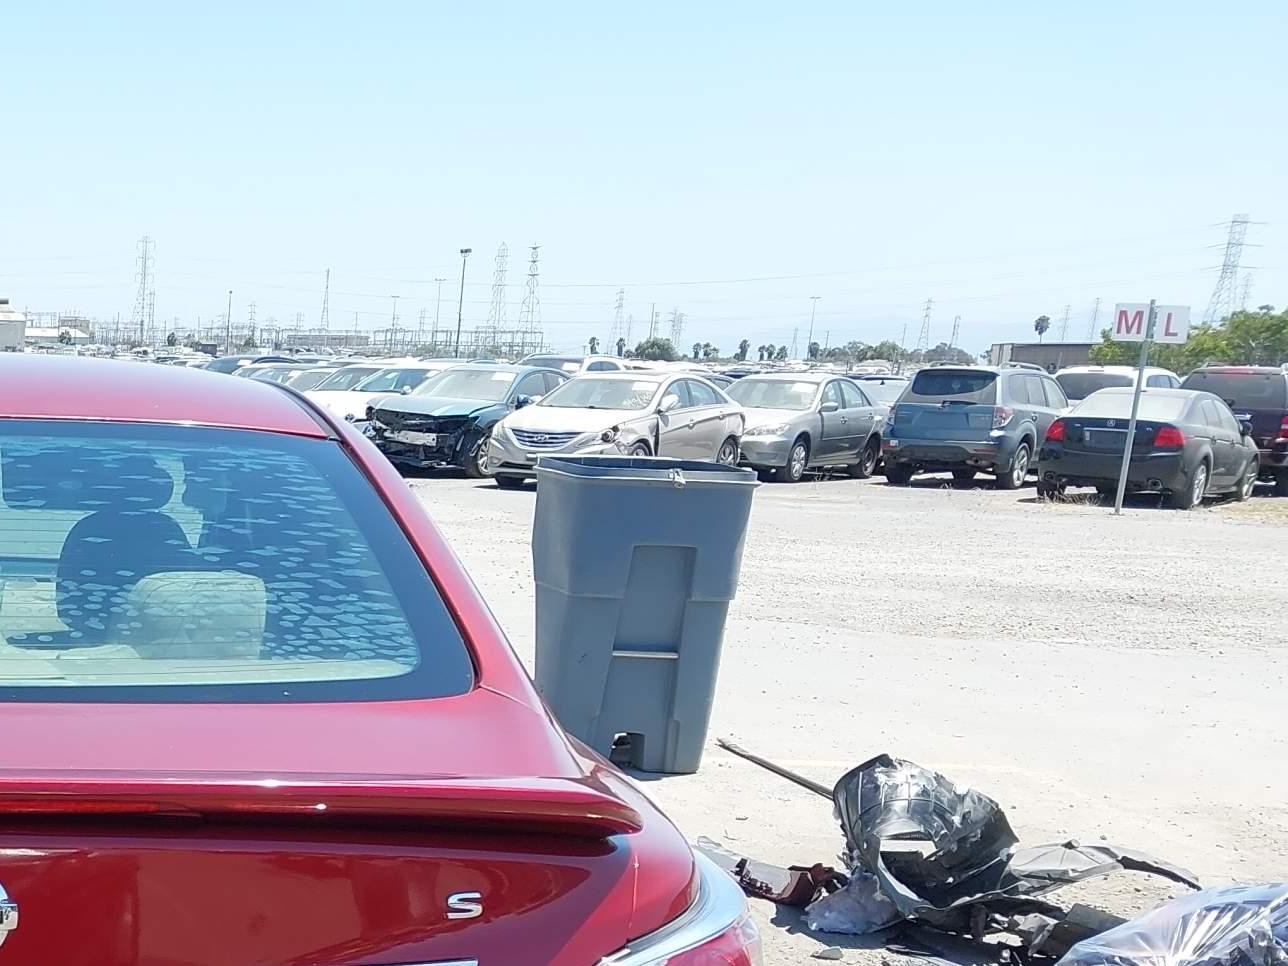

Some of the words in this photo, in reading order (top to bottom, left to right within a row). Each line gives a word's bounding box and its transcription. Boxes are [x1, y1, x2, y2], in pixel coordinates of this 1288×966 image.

[1116, 309, 1145, 335] M
[1164, 312, 1179, 337] L
[446, 892, 483, 919] S
